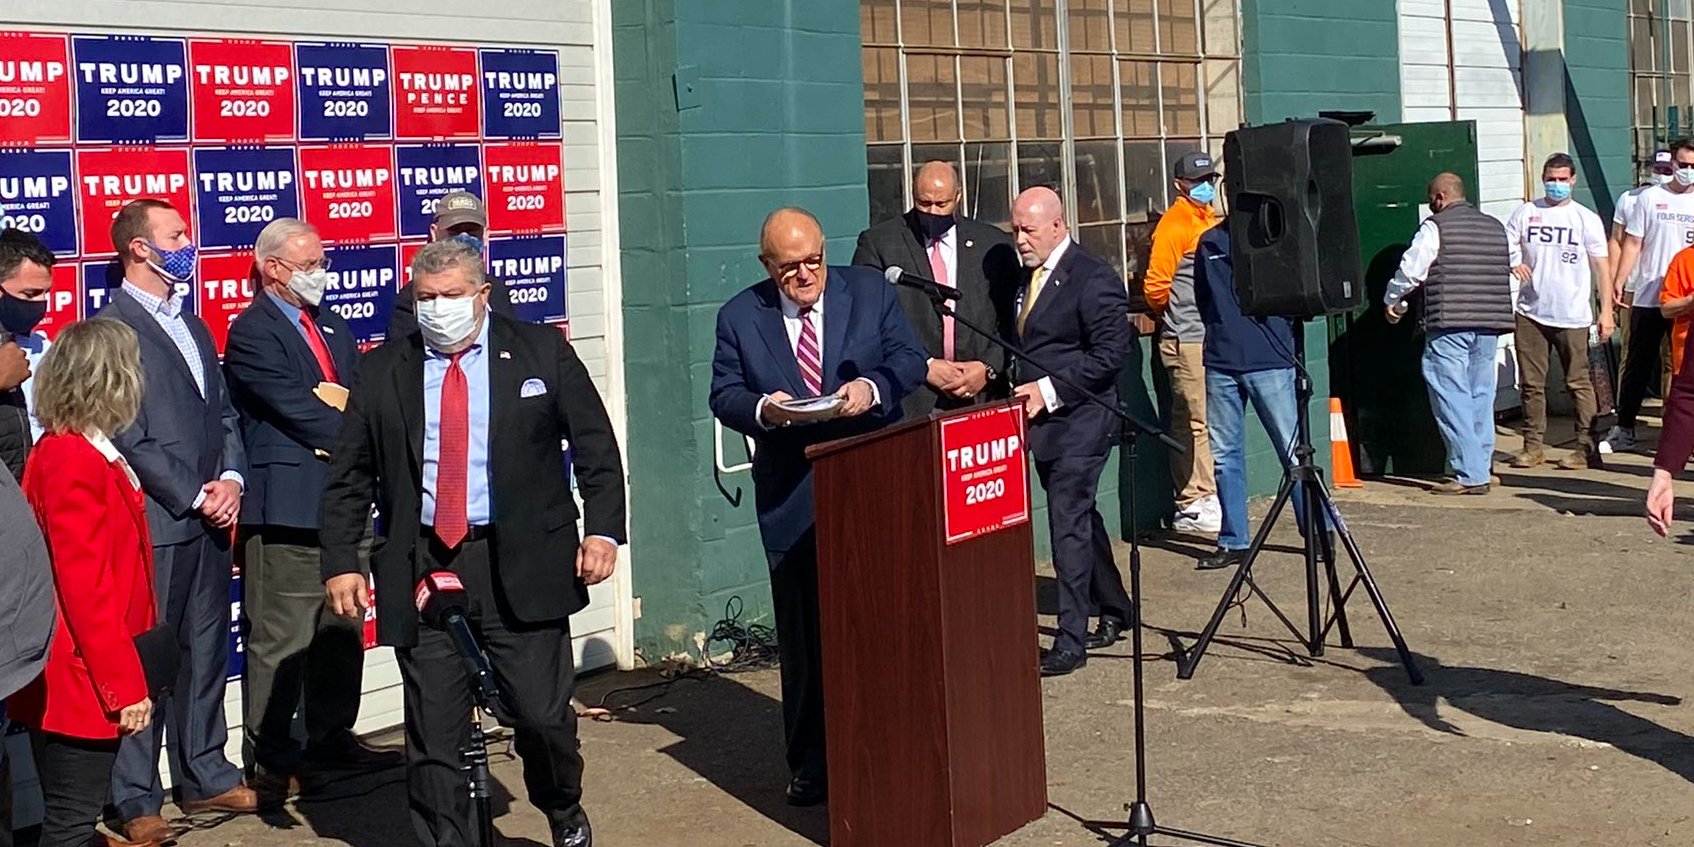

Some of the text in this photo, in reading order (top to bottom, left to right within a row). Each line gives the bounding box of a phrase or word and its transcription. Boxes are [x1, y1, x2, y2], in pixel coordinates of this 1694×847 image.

[0, 61, 64, 82] UMP
[80, 63, 182, 84] TRUMP
[196, 65, 289, 85] TRUMP
[301, 67, 386, 87] TRUMP
[485, 72, 556, 89] TRUMP
[400, 73, 473, 91] TRUMP
[0, 98, 41, 117] 020
[106, 99, 161, 117] 2020
[220, 99, 270, 117] 2020
[407, 92, 468, 105] PENCE
[324, 100, 368, 117] 2020
[504, 102, 541, 117] 2020
[199, 171, 292, 192] TRUMP
[304, 168, 389, 189] TRUMP
[400, 166, 478, 186] TRUMP
[488, 164, 559, 183] TRUMP
[0, 176, 68, 199] UMP
[83, 173, 185, 196] TRUMP
[328, 200, 373, 219] 2020
[507, 194, 545, 211] 2020
[0, 214, 46, 233] 020
[224, 205, 274, 223] 2020
[1527, 225, 1579, 246] FSTL
[491, 256, 562, 277] TRUMP
[1561, 251, 1578, 264] 92
[326, 267, 394, 291] RUMP
[204, 278, 257, 300] TRU
[509, 286, 548, 304] 2020
[947, 434, 1020, 472] TRUMP
[965, 478, 1005, 506] 2020
